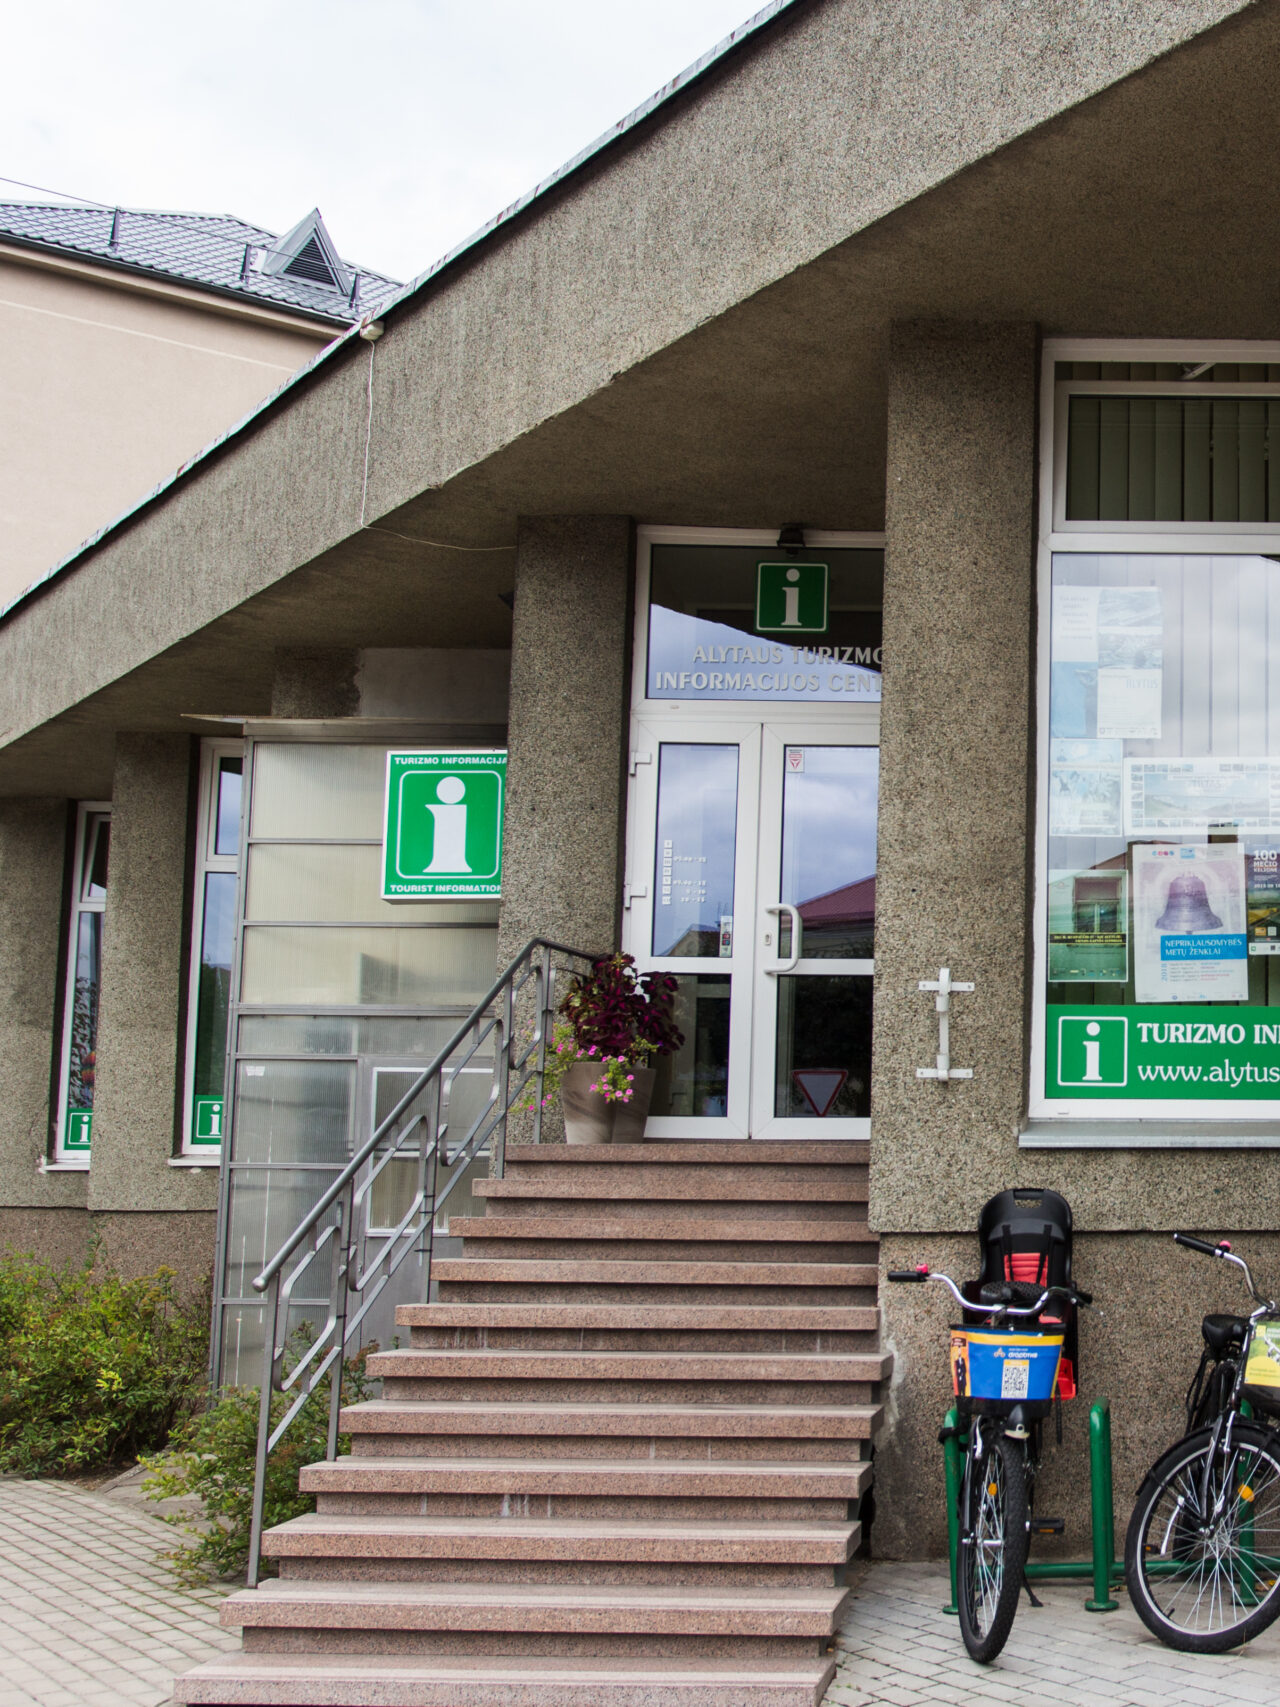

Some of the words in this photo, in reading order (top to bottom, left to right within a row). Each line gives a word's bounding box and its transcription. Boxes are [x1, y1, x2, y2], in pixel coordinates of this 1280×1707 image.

[692, 644, 784, 665] ALYTAUS
[655, 671, 820, 692] INFORMACIJOS
[827, 673, 882, 693] CENT
[394, 757, 439, 765] TURIZMO
[442, 756, 507, 765] INFORMACIJA
[1253, 849, 1278, 861] 100
[390, 885, 434, 893] TOURIST
[1137, 1023, 1246, 1044] TURIZMO
